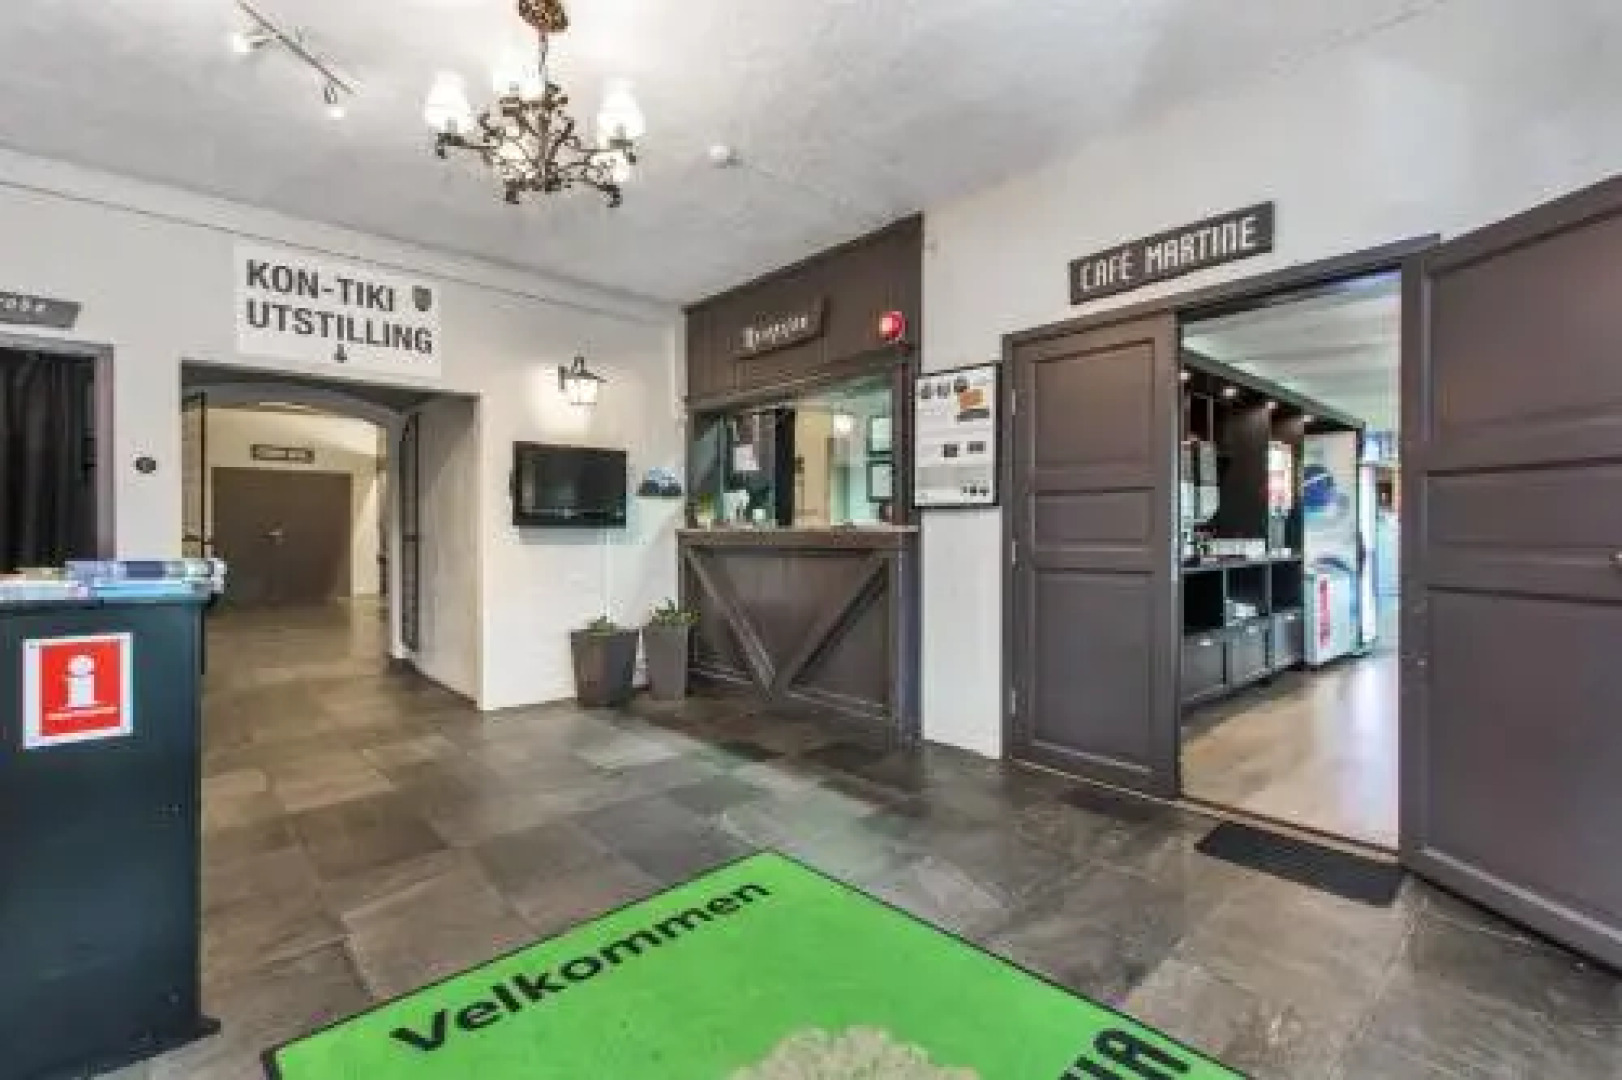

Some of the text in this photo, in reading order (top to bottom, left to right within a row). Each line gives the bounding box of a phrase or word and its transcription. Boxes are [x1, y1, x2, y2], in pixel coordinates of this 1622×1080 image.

[1144, 214, 1257, 274] MARTINE
[246, 258, 395, 313] KON-TIKI
[246, 298, 433, 355] UTSTILLING
[389, 882, 770, 1052] Velkommen
